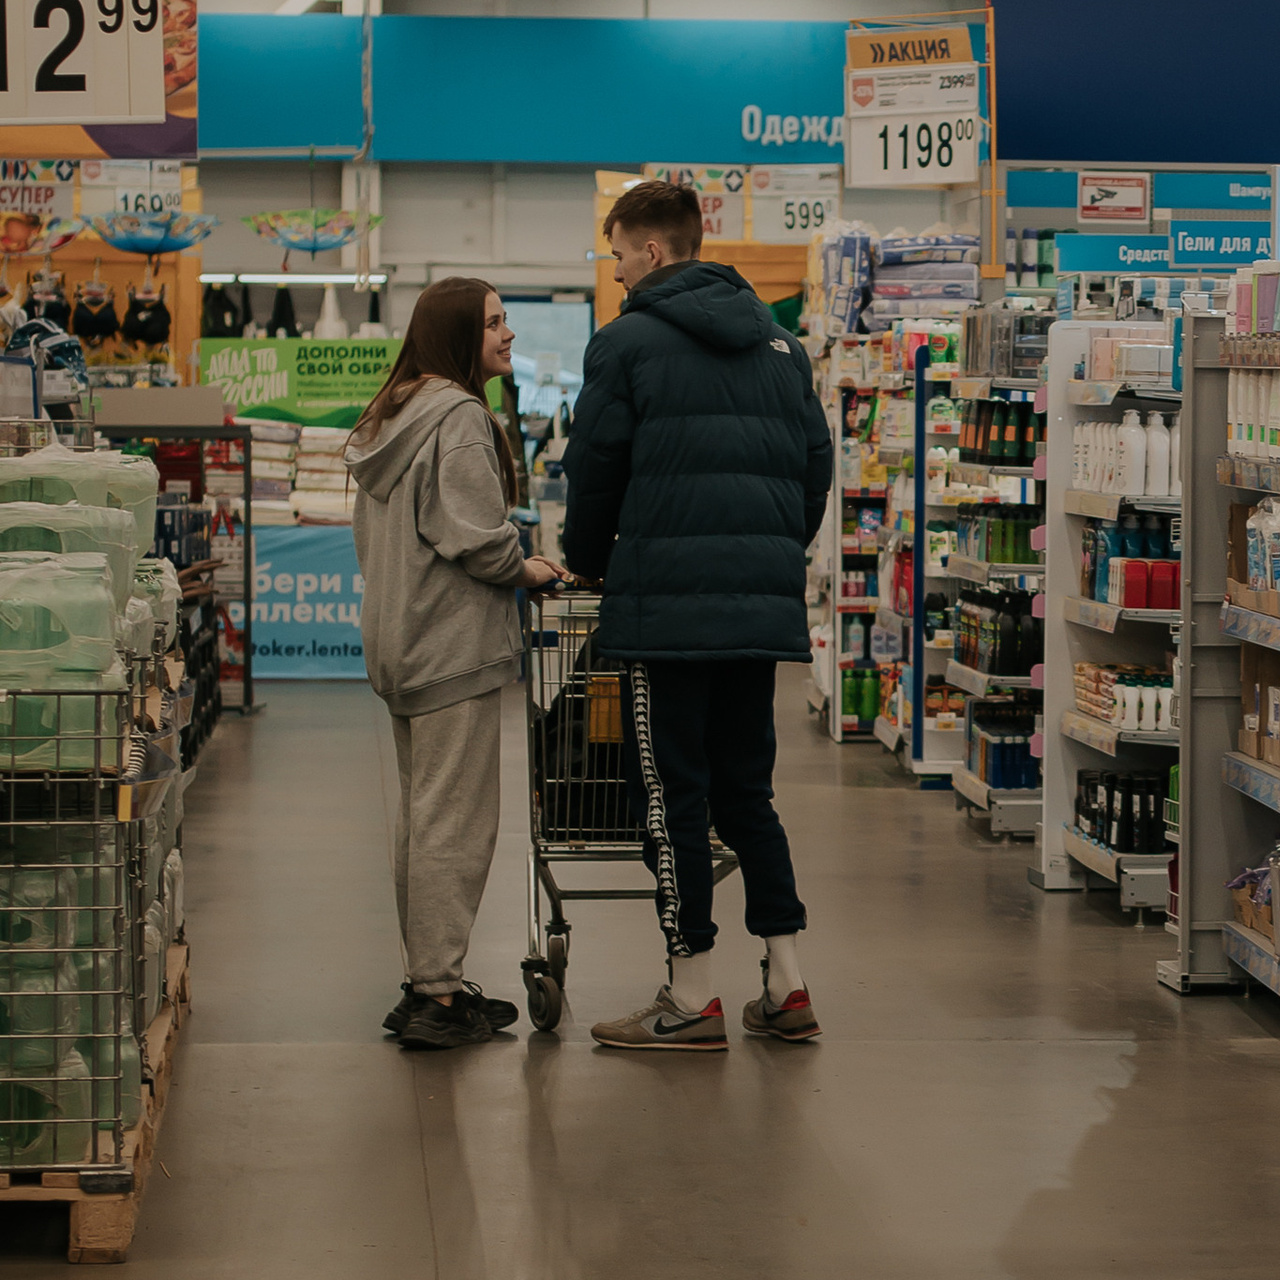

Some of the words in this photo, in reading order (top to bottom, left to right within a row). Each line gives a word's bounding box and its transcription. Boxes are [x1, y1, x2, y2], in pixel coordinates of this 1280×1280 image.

[887, 38, 951, 64] АКЦИЯ
[741, 104, 845, 147] Одежд
[879, 121, 954, 170] 1198
[956, 118, 974, 141] 00
[0, 186, 54, 204] СУПЕР
[784, 201, 824, 229] 599
[1119, 245, 1170, 265] Средств
[1177, 231, 1215, 252] Гели
[1219, 236, 1252, 255] для
[296, 346, 387, 362] ДОПОЛНИ
[296, 362, 343, 376] СВОЙ
[348, 362, 392, 376] ОБРА
[253, 561, 343, 603] бери
[227, 600, 361, 629] оллекц
